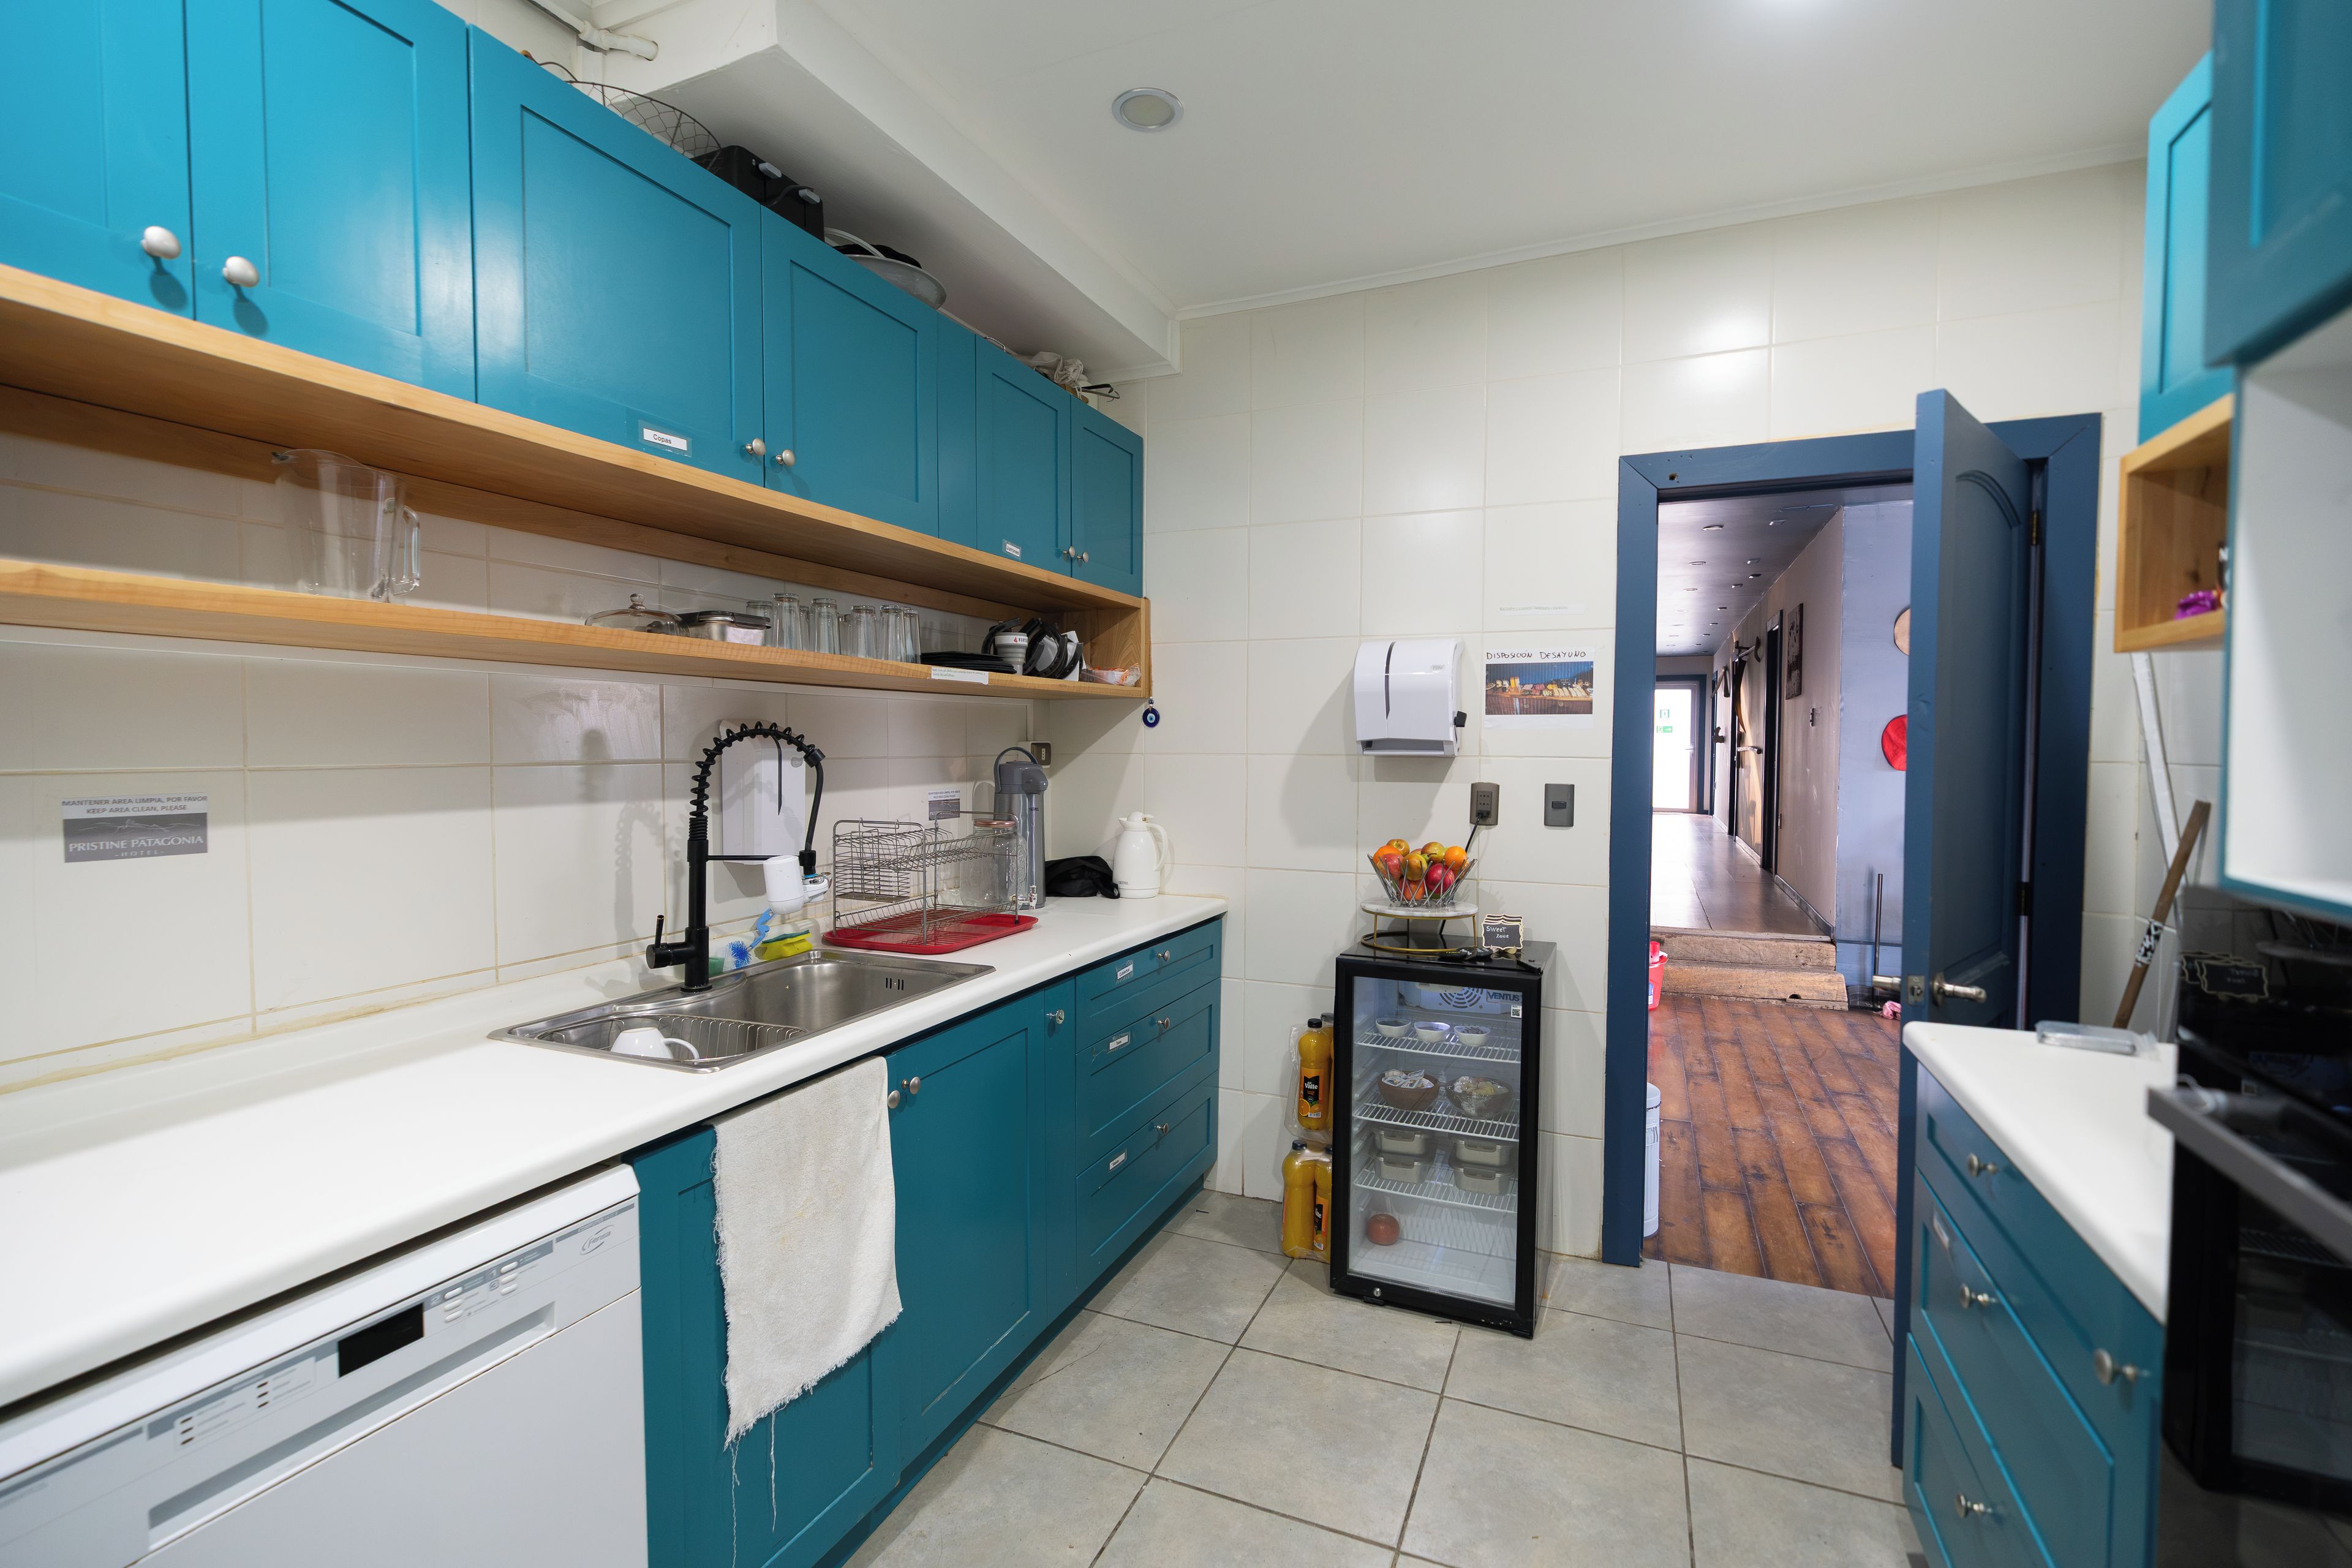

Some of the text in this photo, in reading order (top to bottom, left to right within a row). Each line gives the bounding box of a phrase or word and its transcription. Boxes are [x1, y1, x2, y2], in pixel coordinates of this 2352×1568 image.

[653, 434, 672, 444] Copas
[1539, 650, 1586, 660] DESAYUNO
[69, 835, 205, 852] PRISTINE PATAGONIA
[1487, 991, 1520, 1002] VENTUS
[587, 1231, 611, 1248] fensa
